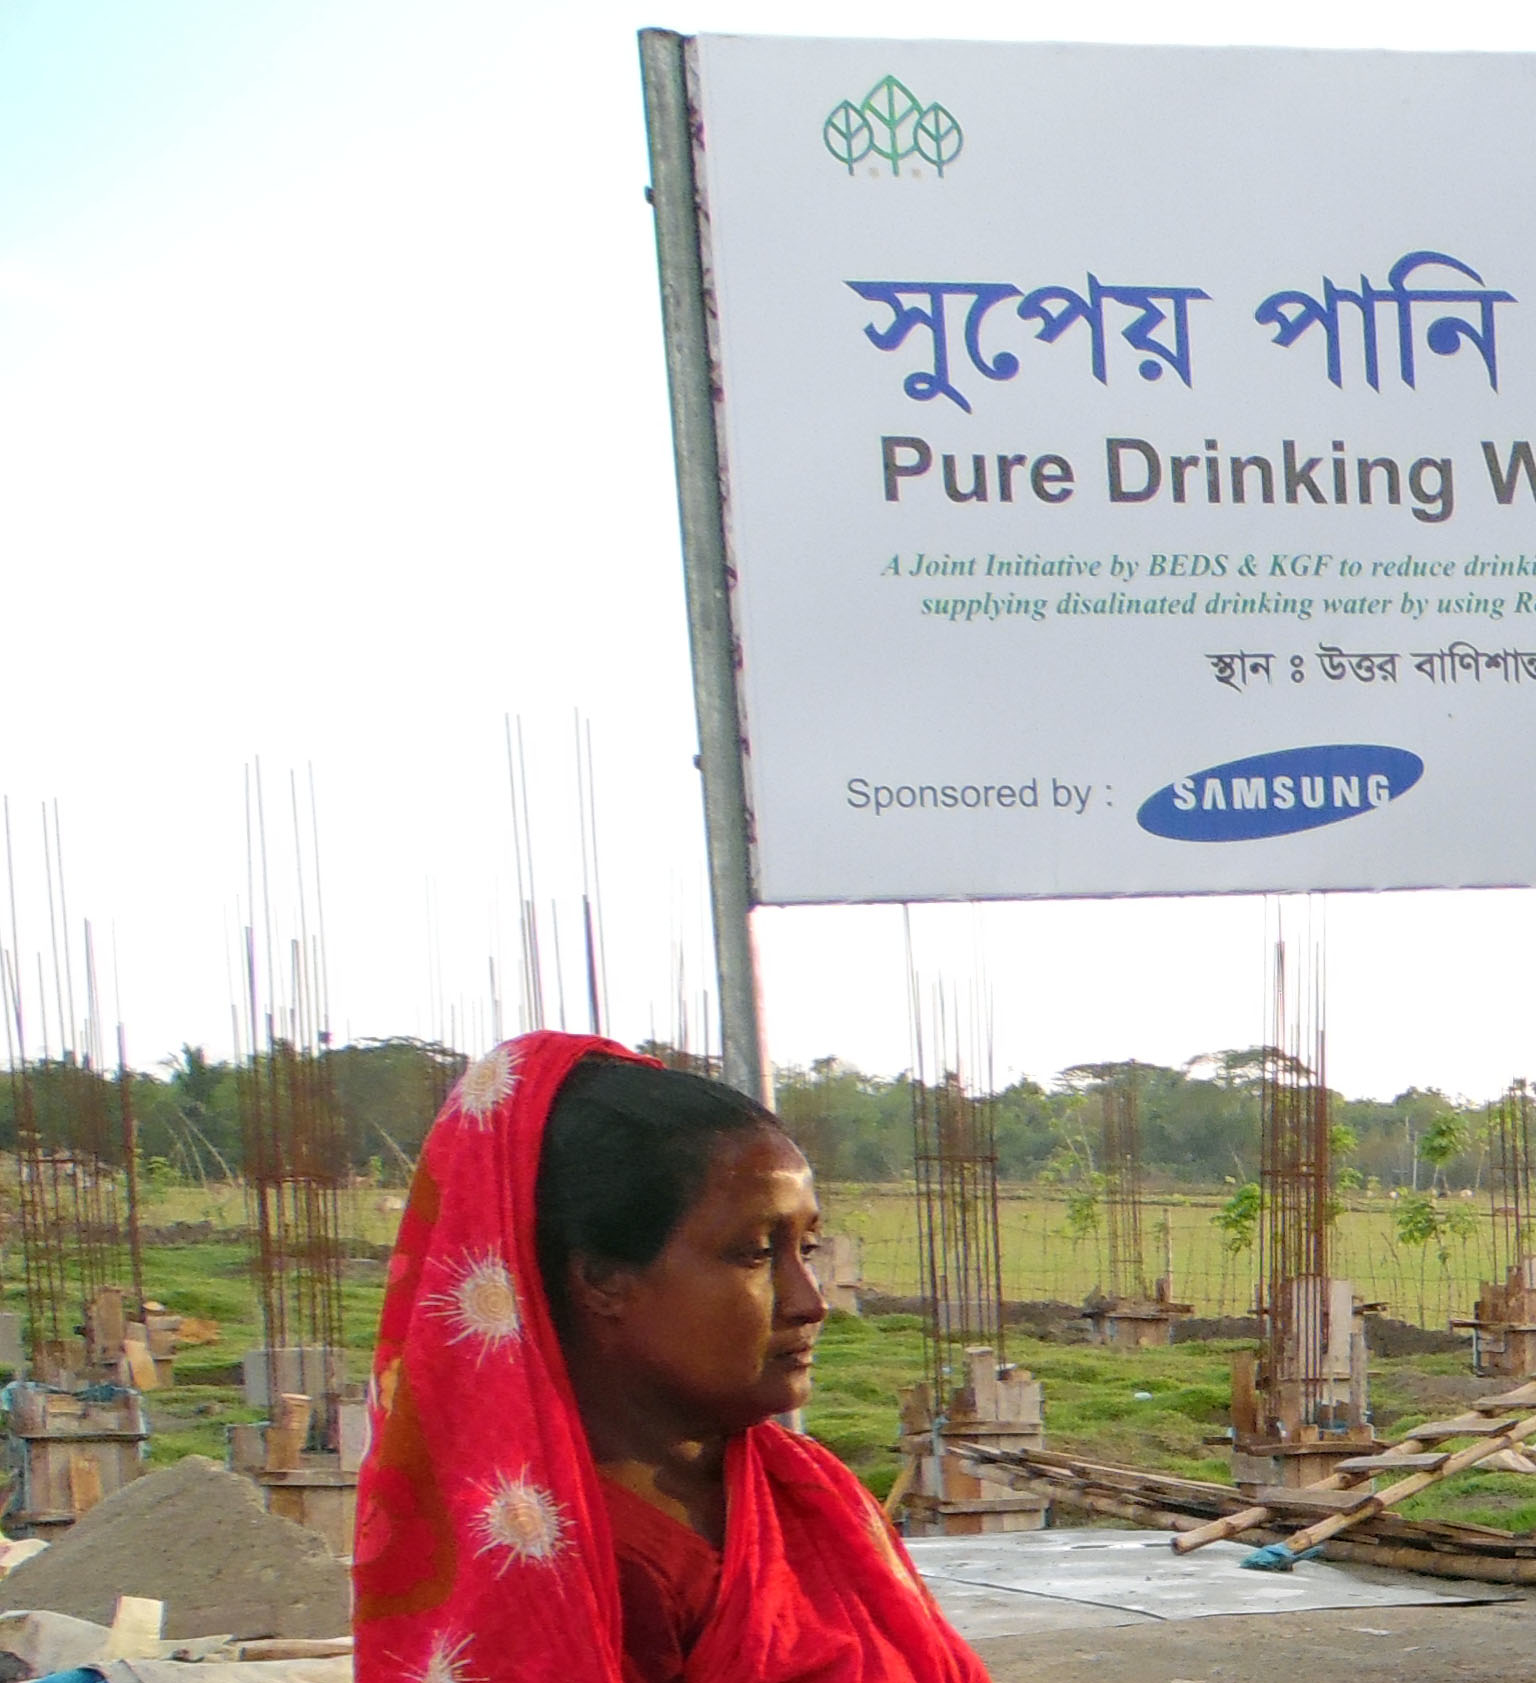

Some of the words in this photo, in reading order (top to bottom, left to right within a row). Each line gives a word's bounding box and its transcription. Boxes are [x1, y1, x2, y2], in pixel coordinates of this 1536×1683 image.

[843, 271, 1213, 415] সুপেয়
[1254, 250, 1519, 394] পানি
[880, 435, 1075, 504] Pure
[1105, 437, 1454, 524] Drinking
[880, 554, 901, 577] A
[908, 553, 977, 577] Joint
[985, 553, 1102, 577] Initiative
[1109, 554, 1140, 583] by
[1148, 553, 1229, 577] BEDS
[1237, 553, 1258, 577] &
[1269, 554, 1334, 577] KGF
[1339, 559, 1363, 577] to
[1371, 554, 1456, 577] reduce
[921, 591, 1049, 622] supplying
[1056, 591, 1198, 615] disalinated
[1204, 591, 1314, 621] drinking
[1323, 596, 1393, 615] water
[1400, 591, 1429, 621] by
[1436, 591, 1506, 620] using
[1204, 649, 1276, 693] স্থান
[1314, 641, 1402, 683] উত্তর
[847, 777, 1039, 817] Sponsored
[1051, 777, 1092, 815] by
[1171, 777, 1392, 811] SAMSUNG
